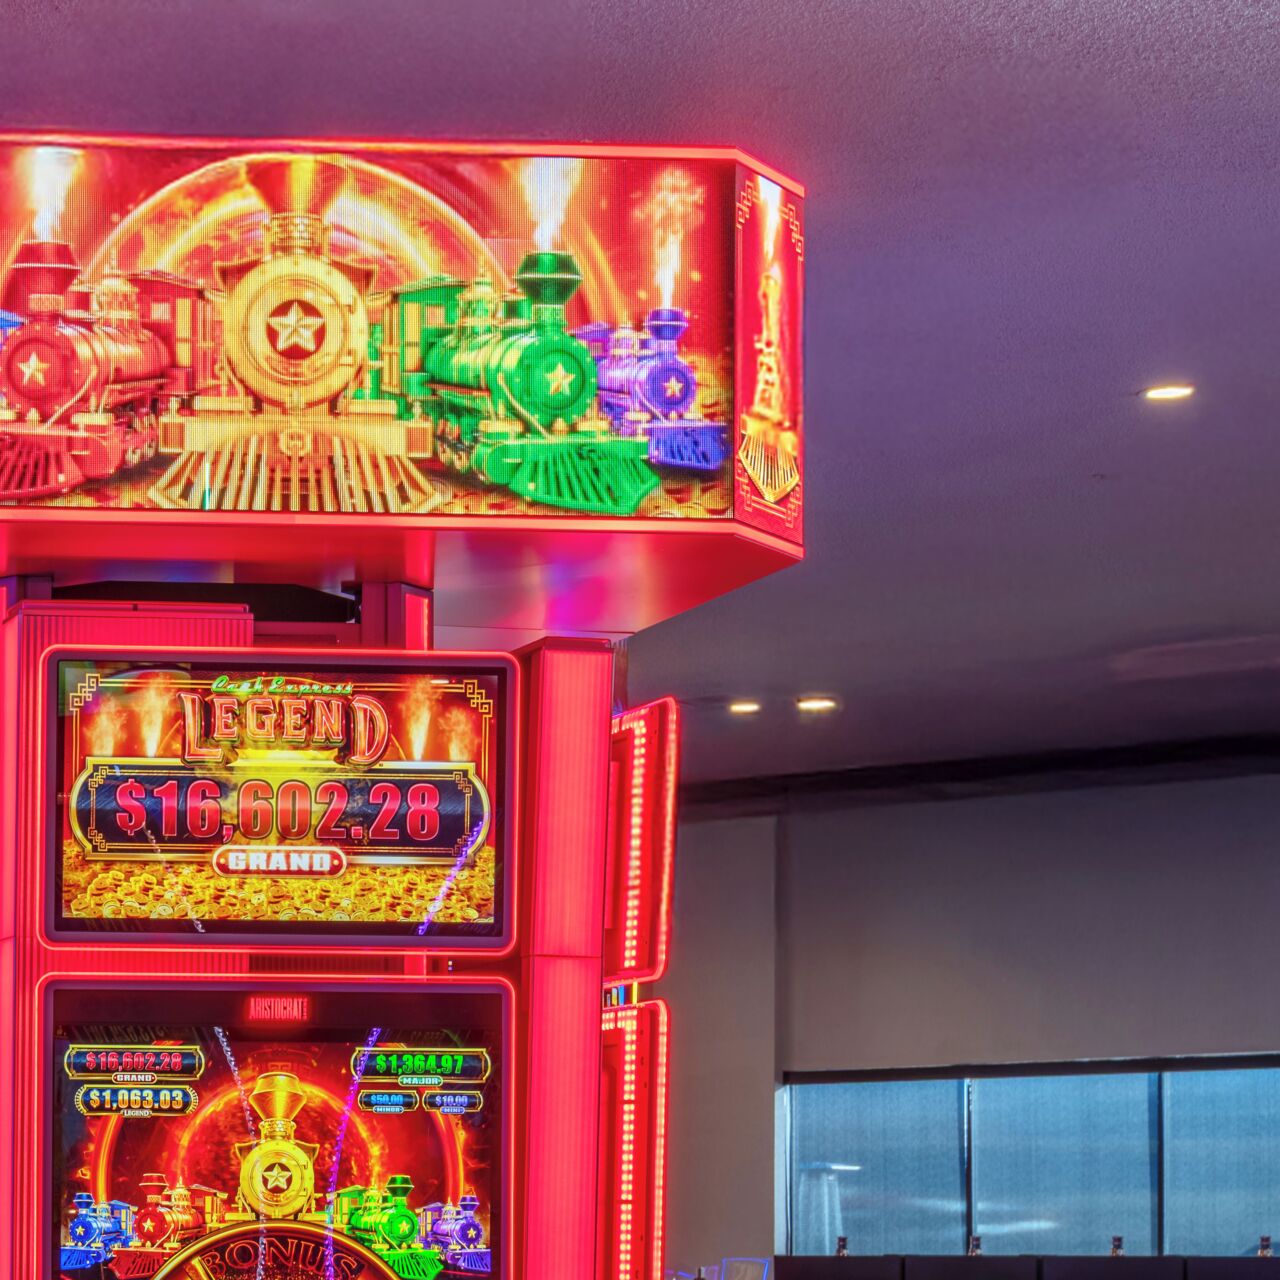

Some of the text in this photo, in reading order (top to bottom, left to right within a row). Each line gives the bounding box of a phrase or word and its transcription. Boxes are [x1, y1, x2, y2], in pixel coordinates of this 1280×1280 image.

[211, 675, 354, 696] Cash Express
[178, 691, 389, 767] LEGEND
[114, 777, 440, 844] $16,602.28
[227, 851, 332, 872] GRAND
[248, 997, 303, 1020] ARISTOCRAT
[86, 1051, 464, 1074] $16,602.28 $1,364.97
[116, 1074, 439, 1085] GRAND MAJOR
[89, 1089, 469, 1110] $1,063.03 $50.00 $10.00
[124, 1109, 151, 1118] LEGEND
